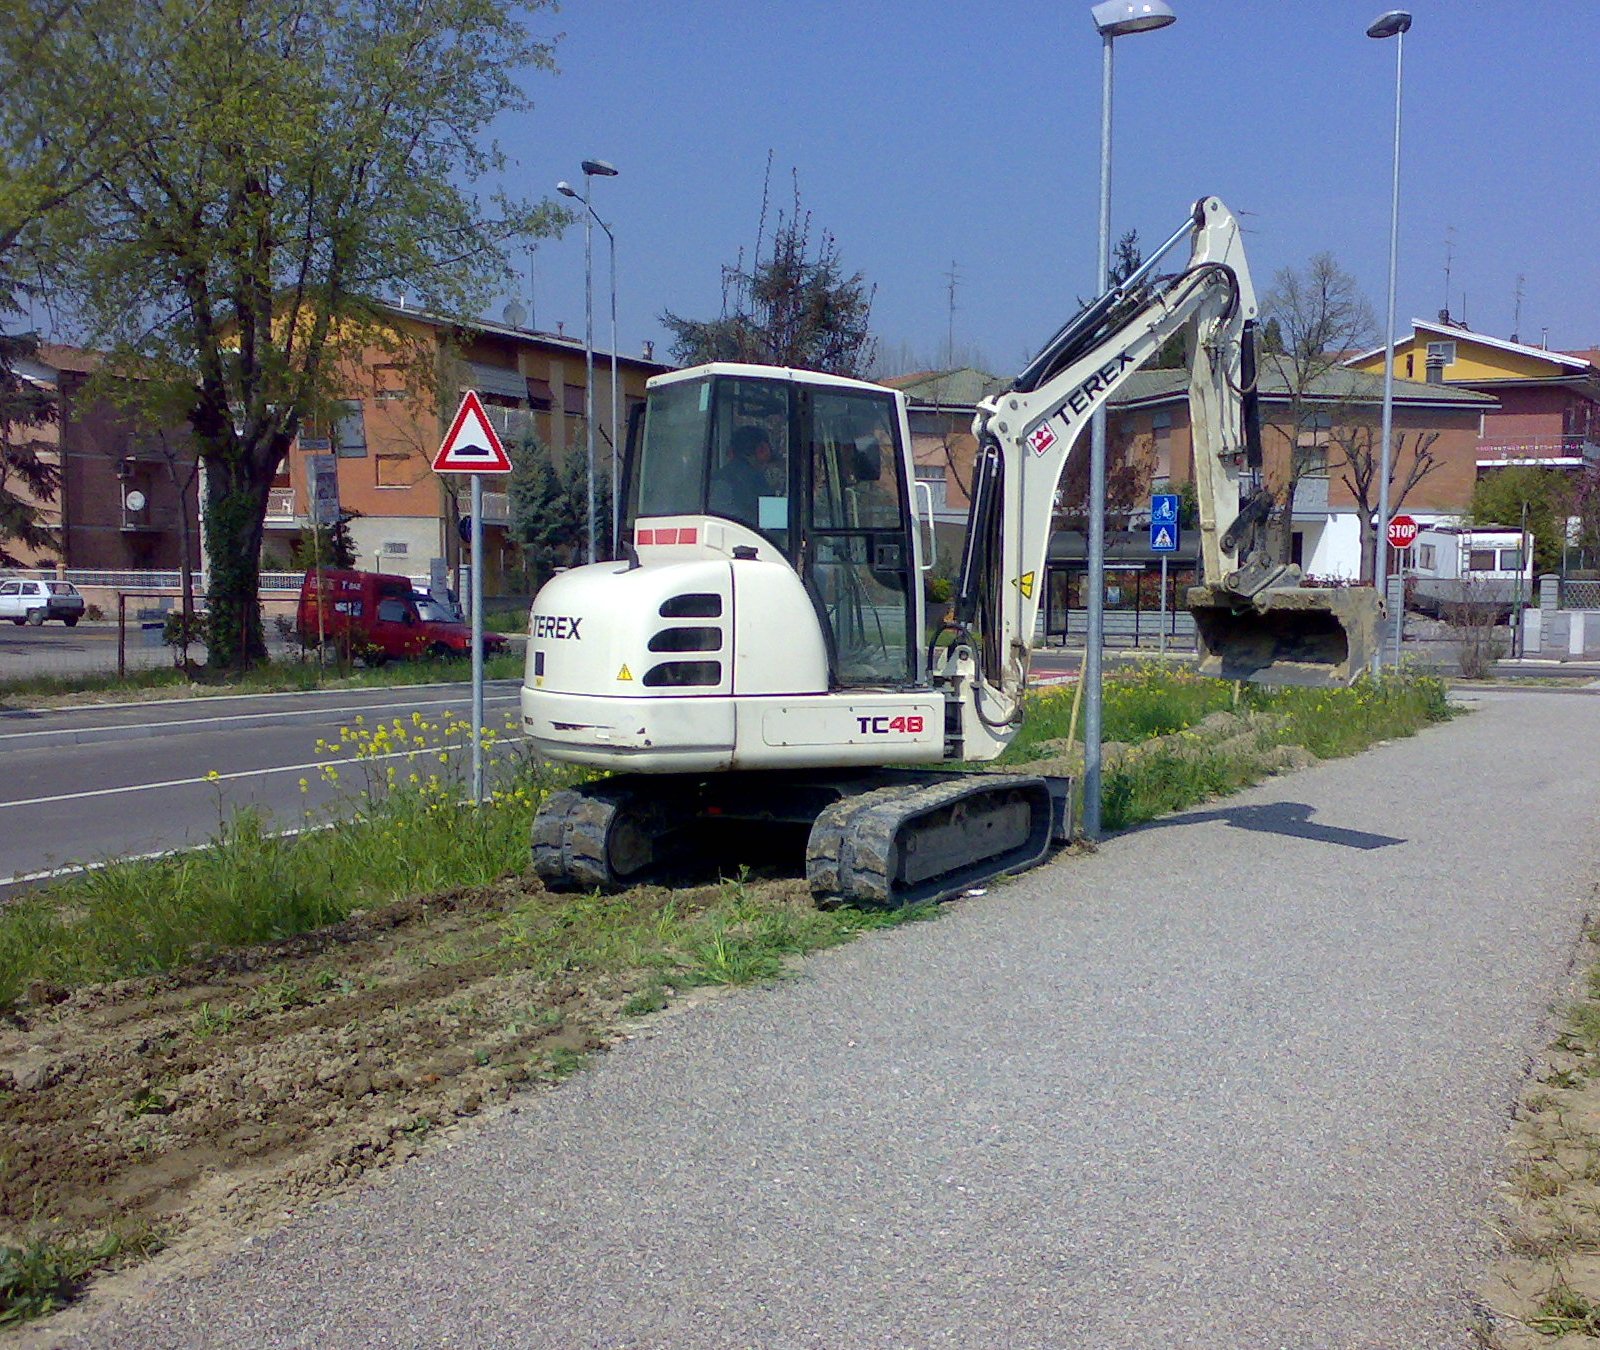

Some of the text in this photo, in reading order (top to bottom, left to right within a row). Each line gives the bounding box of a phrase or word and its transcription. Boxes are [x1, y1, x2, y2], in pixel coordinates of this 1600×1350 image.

[1052, 351, 1136, 425] TEREX
[1388, 524, 1416, 538] STOP
[533, 615, 582, 640] TEREX
[856, 716, 923, 734] TC48
